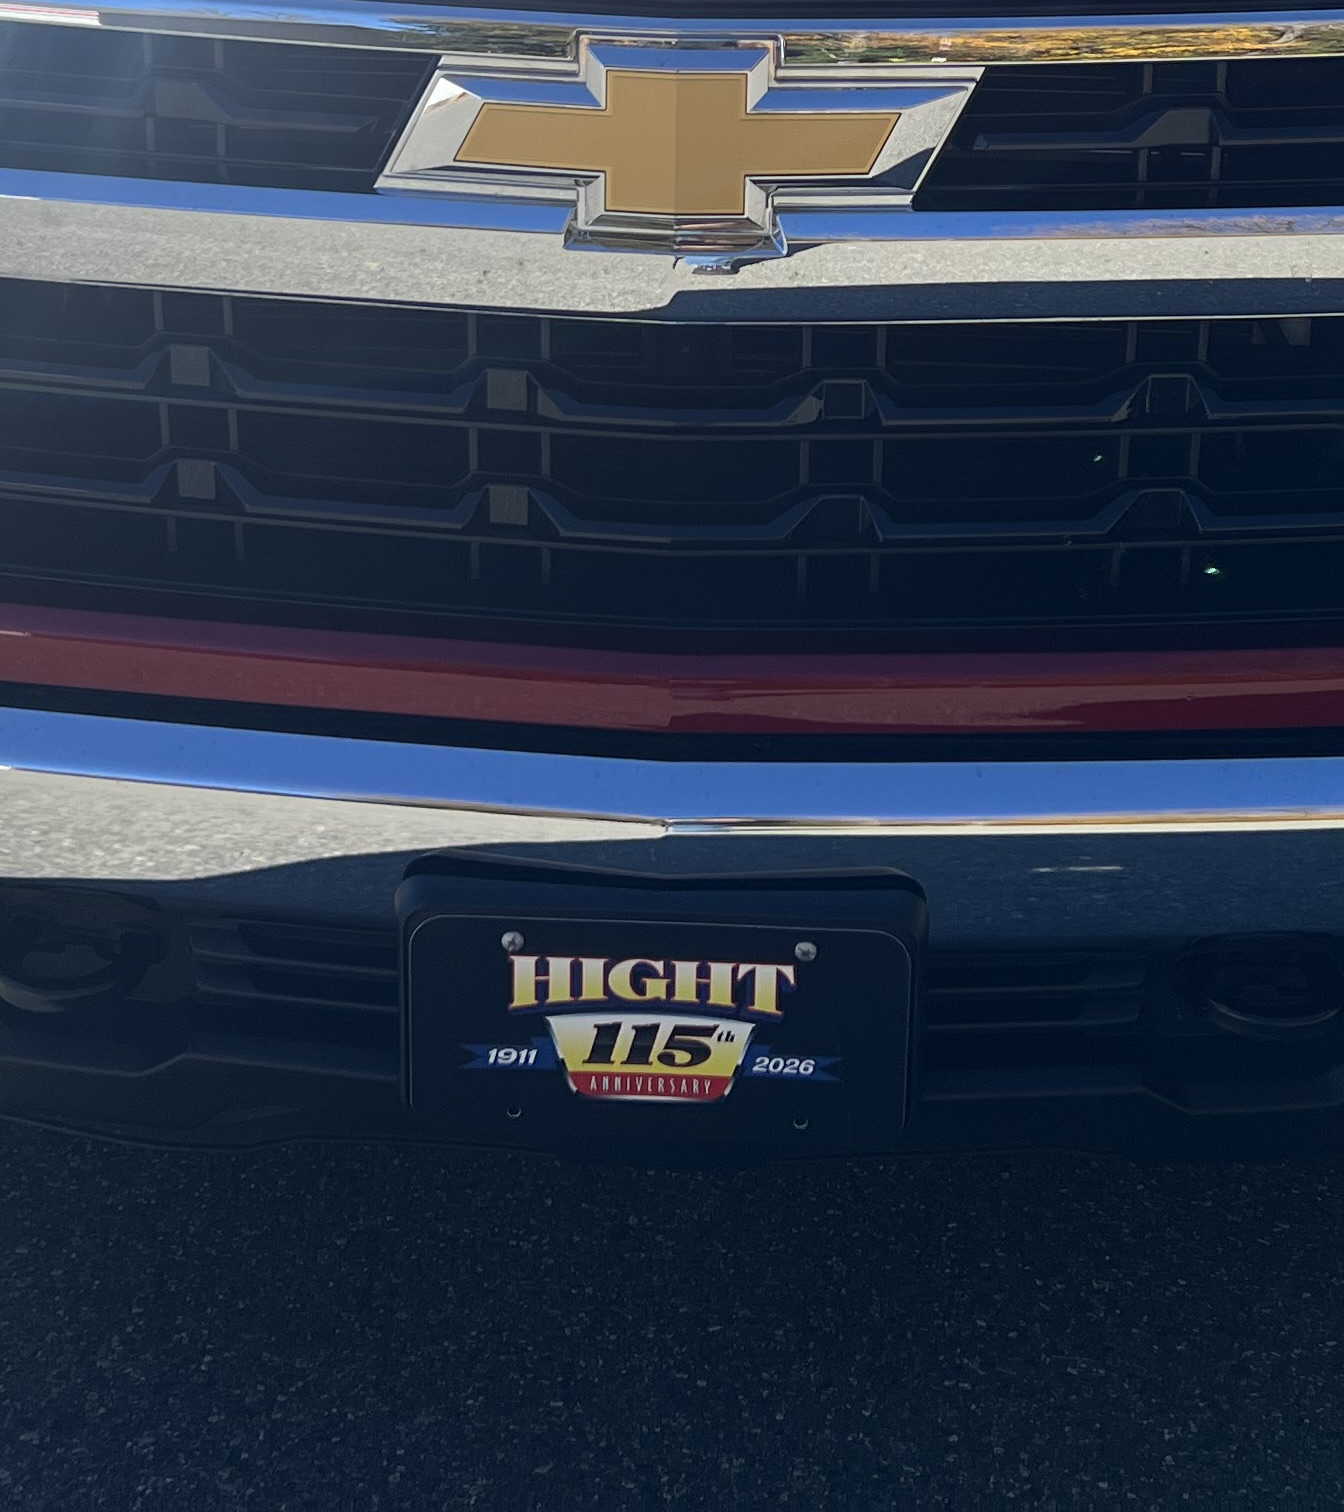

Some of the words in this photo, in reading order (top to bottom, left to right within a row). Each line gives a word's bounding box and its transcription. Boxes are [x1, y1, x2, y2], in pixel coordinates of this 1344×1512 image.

[508, 954, 798, 1017] HIGHT
[487, 1047, 538, 1066] 1911
[751, 1055, 816, 1075] 2026
[589, 1074, 712, 1095] ANNIVERSARY
